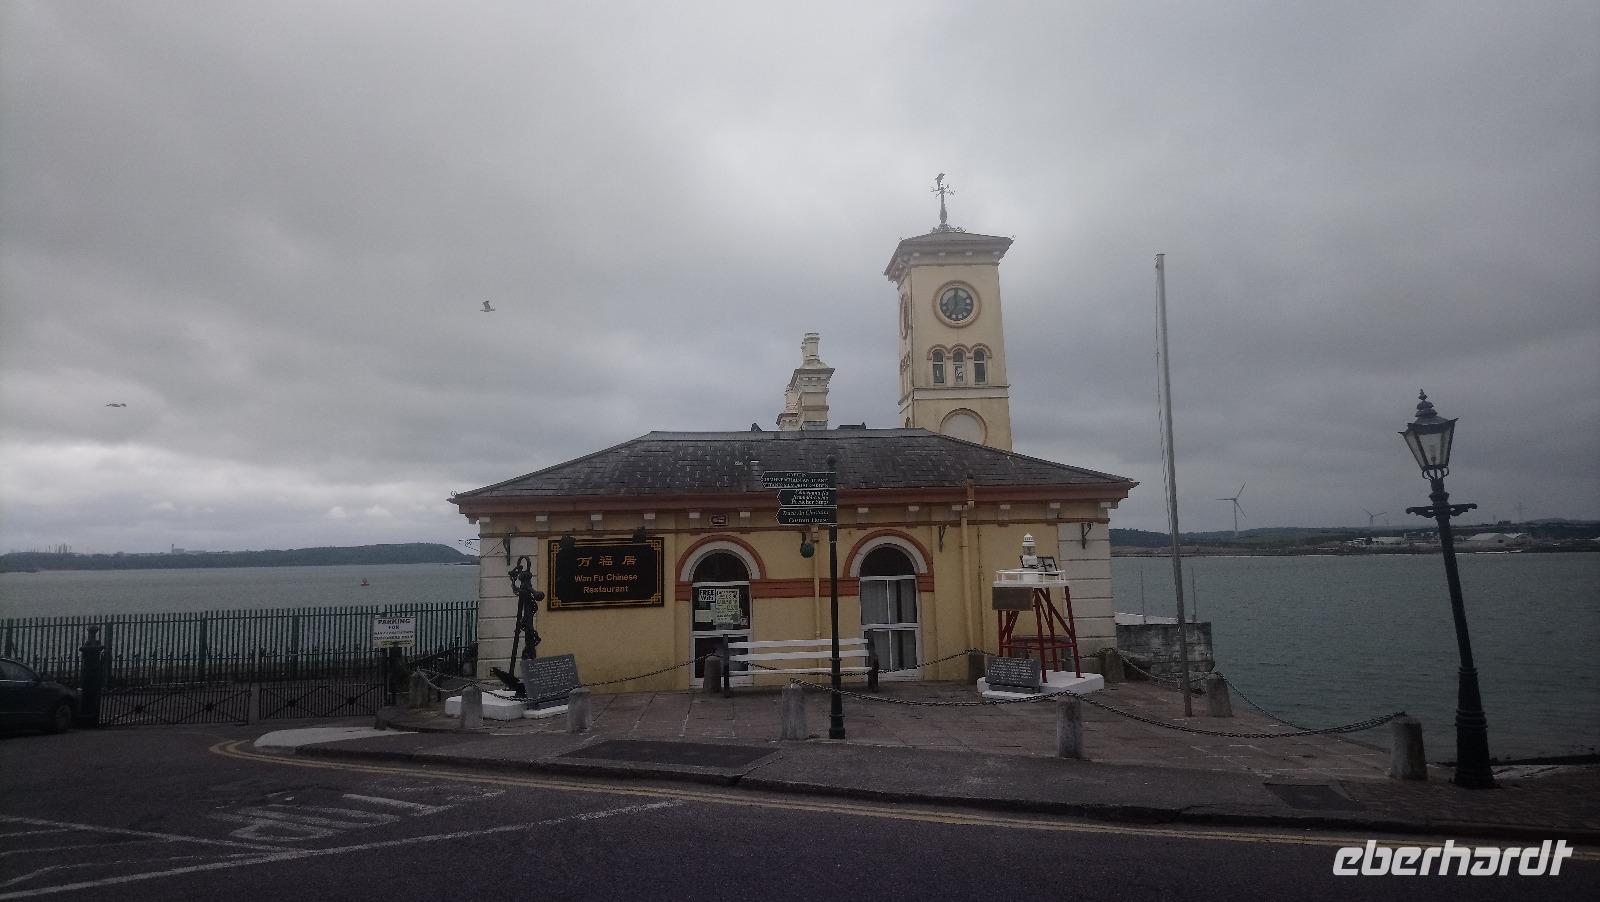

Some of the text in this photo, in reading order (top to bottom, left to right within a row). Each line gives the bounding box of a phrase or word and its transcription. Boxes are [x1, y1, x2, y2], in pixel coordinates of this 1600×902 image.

[574, 573, 638, 583] Wan Fu Chinese
[583, 585, 629, 594] Restaurant
